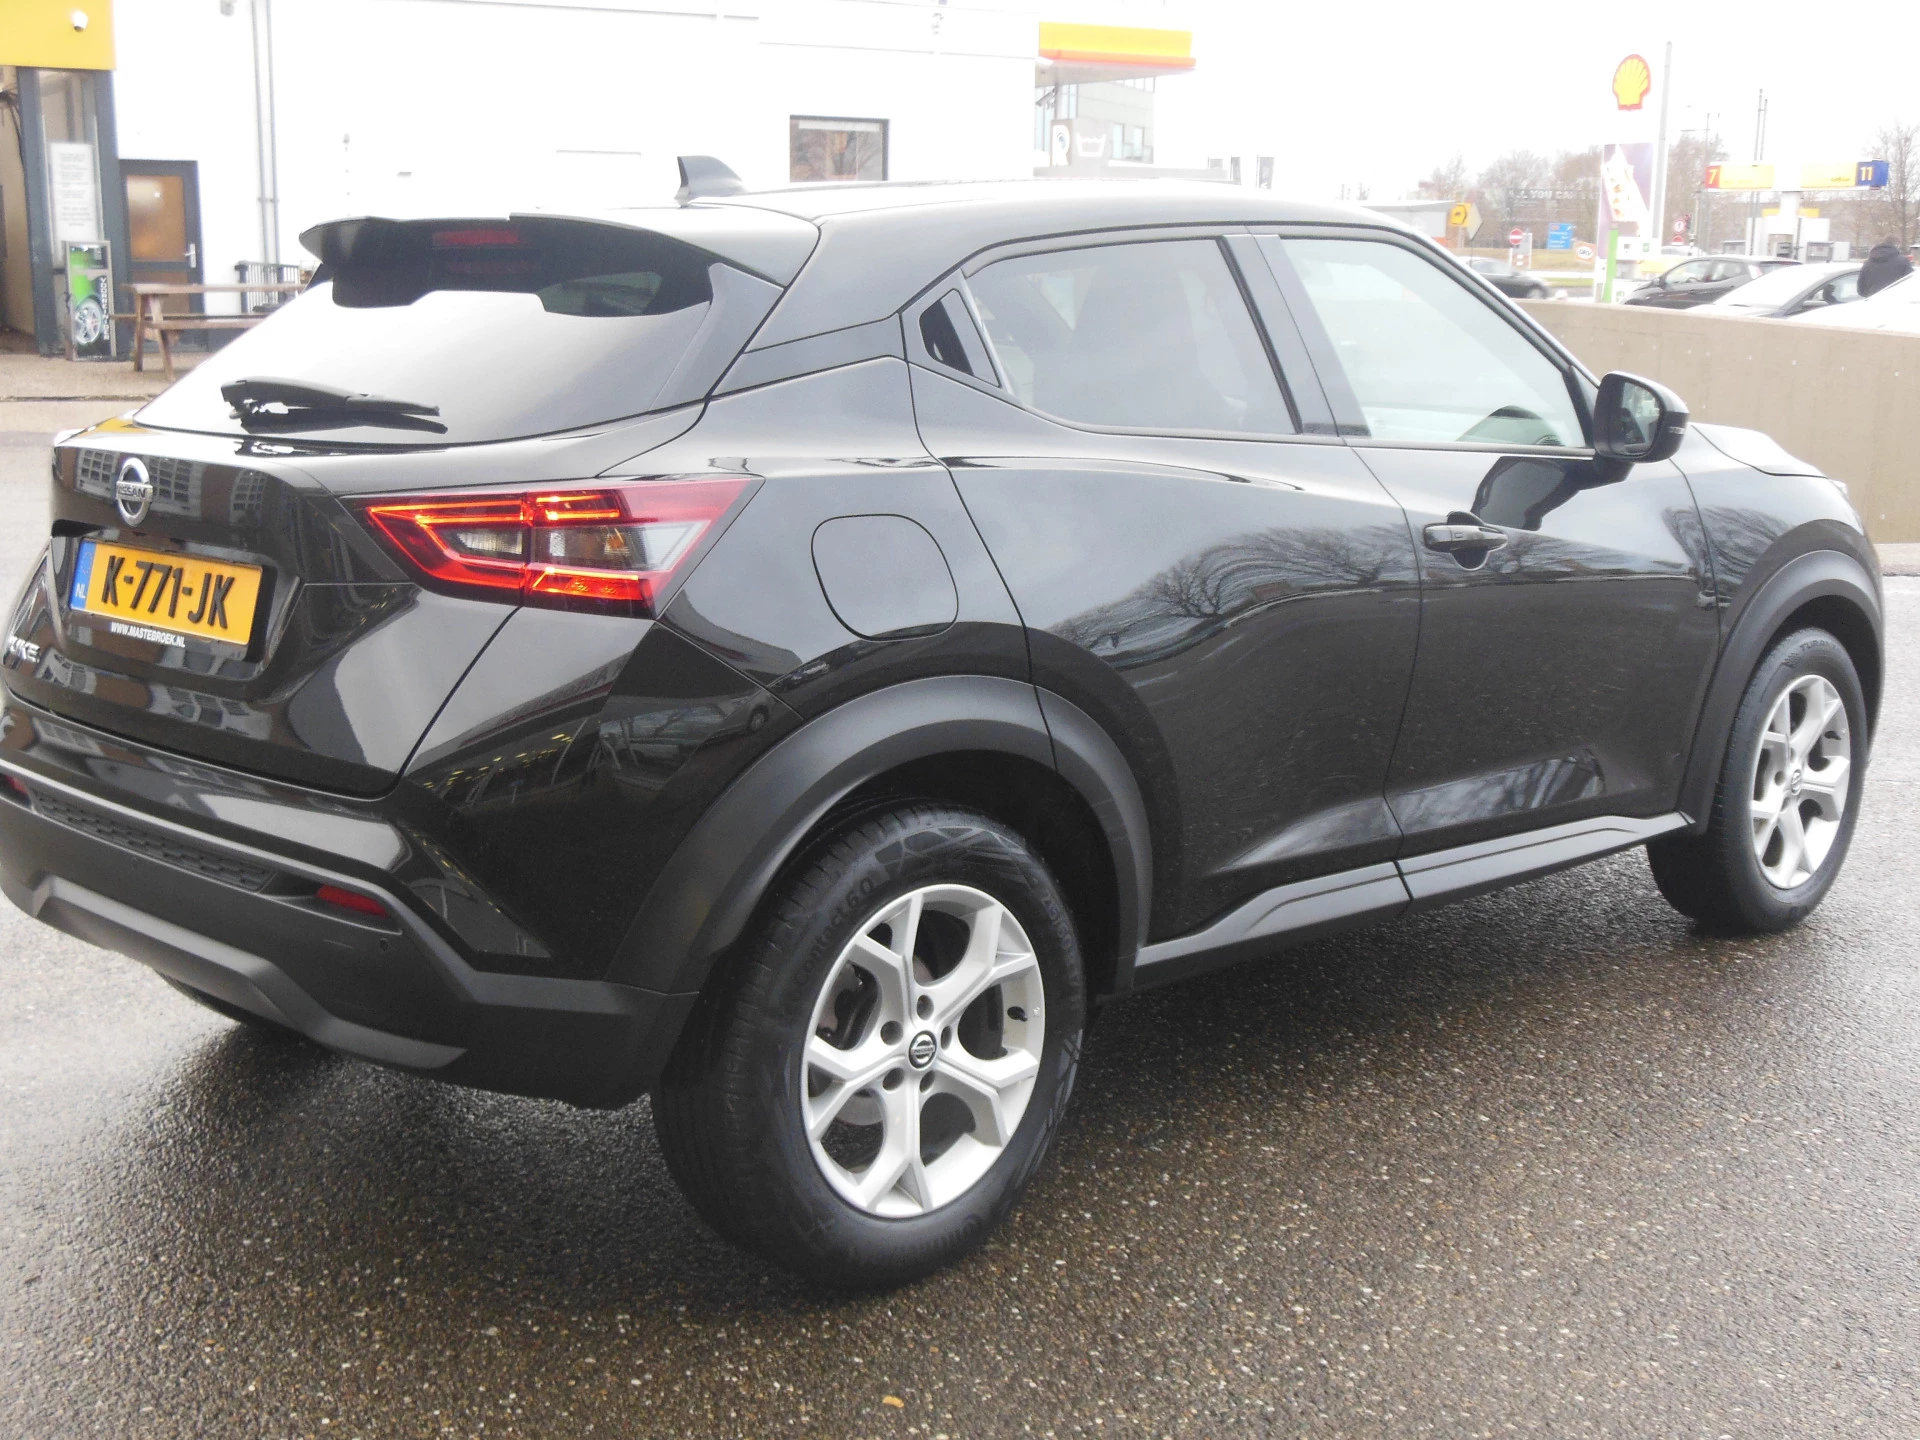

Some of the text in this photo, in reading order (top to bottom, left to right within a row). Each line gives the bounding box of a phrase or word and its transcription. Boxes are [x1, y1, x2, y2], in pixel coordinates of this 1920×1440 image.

[1708, 168, 1718, 185] 7
[1860, 166, 1873, 182] 11
[74, 582, 87, 600] NL
[101, 555, 237, 630] K-771-JK
[111, 621, 186, 649] WWW.MASTEBROEK.NL
